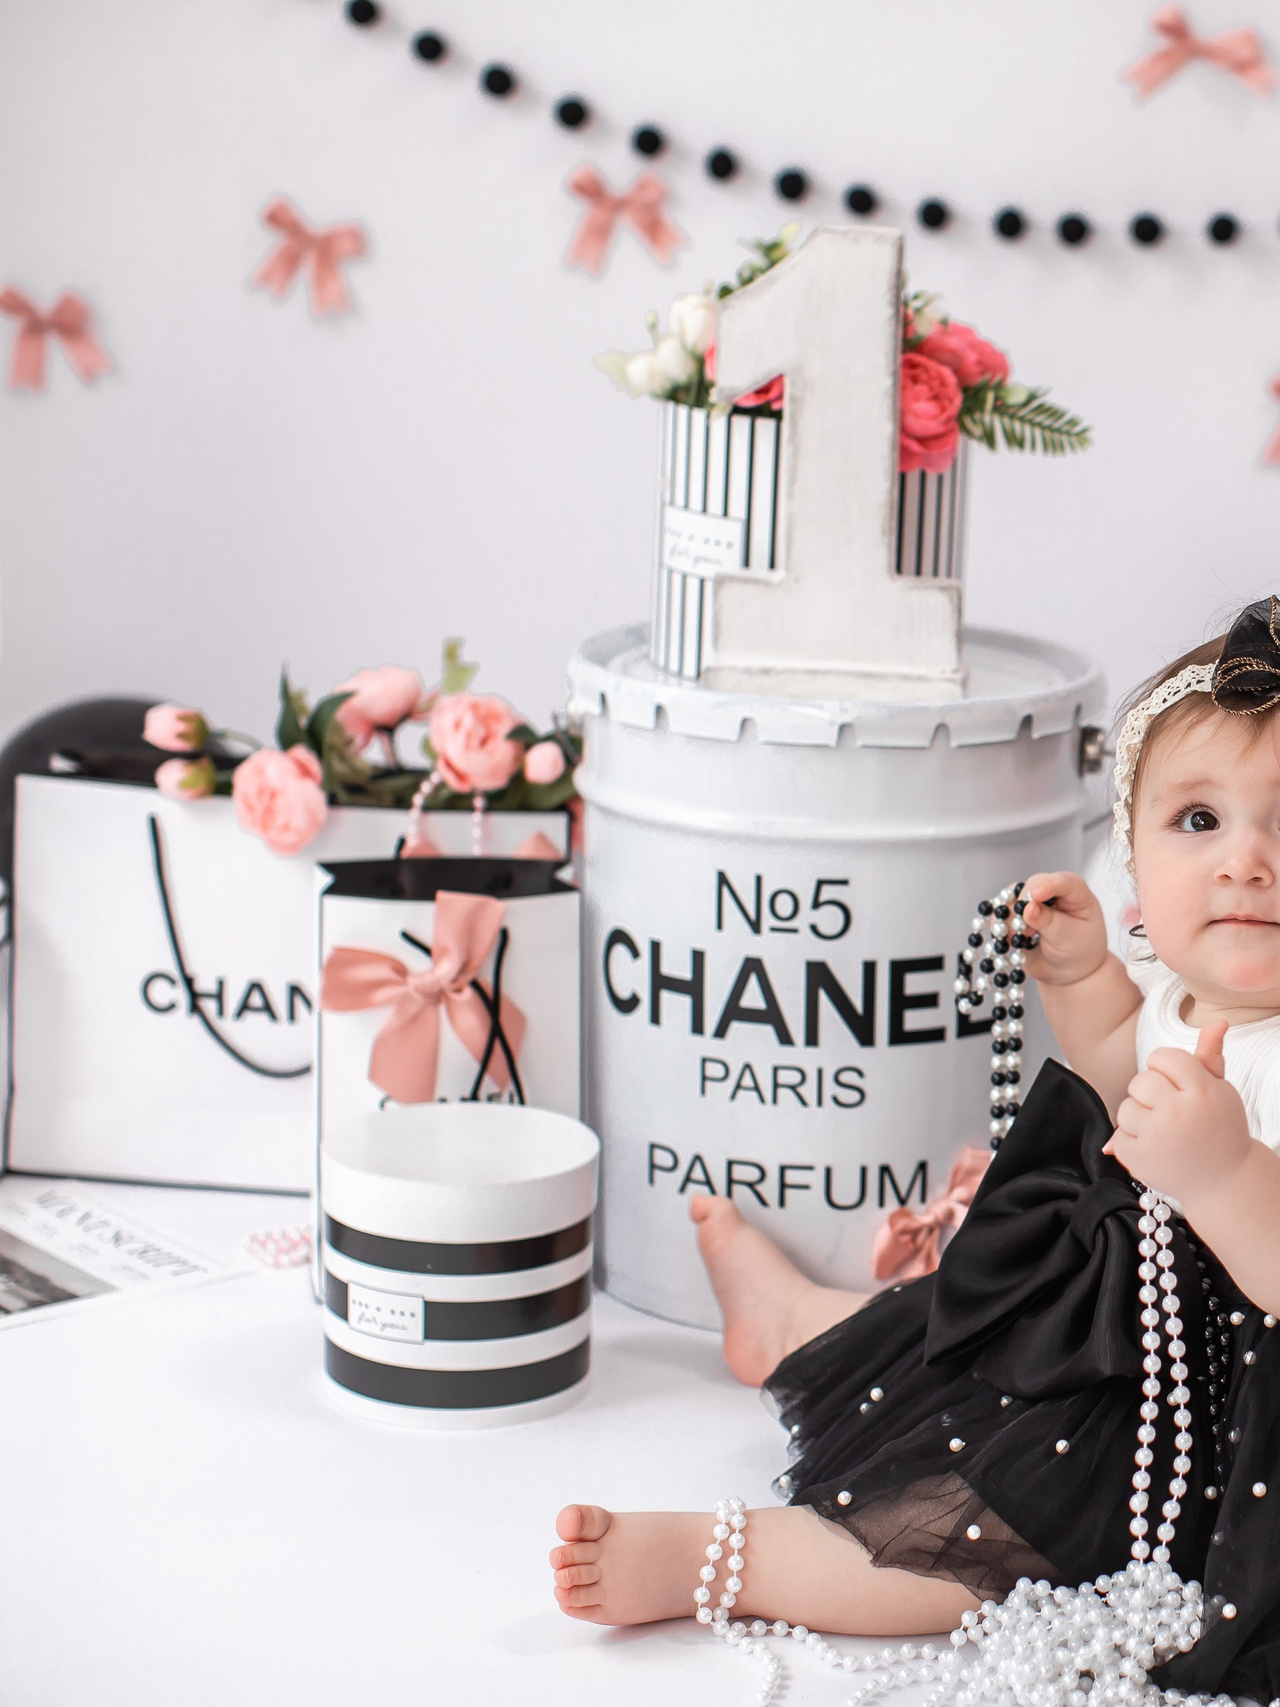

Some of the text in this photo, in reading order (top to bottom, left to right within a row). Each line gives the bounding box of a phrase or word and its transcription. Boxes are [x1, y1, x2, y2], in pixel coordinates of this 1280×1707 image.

[141, 972, 313, 1023] CHAN
[700, 1057, 868, 1109] PARIS
[648, 1142, 929, 1212] PARFUM
